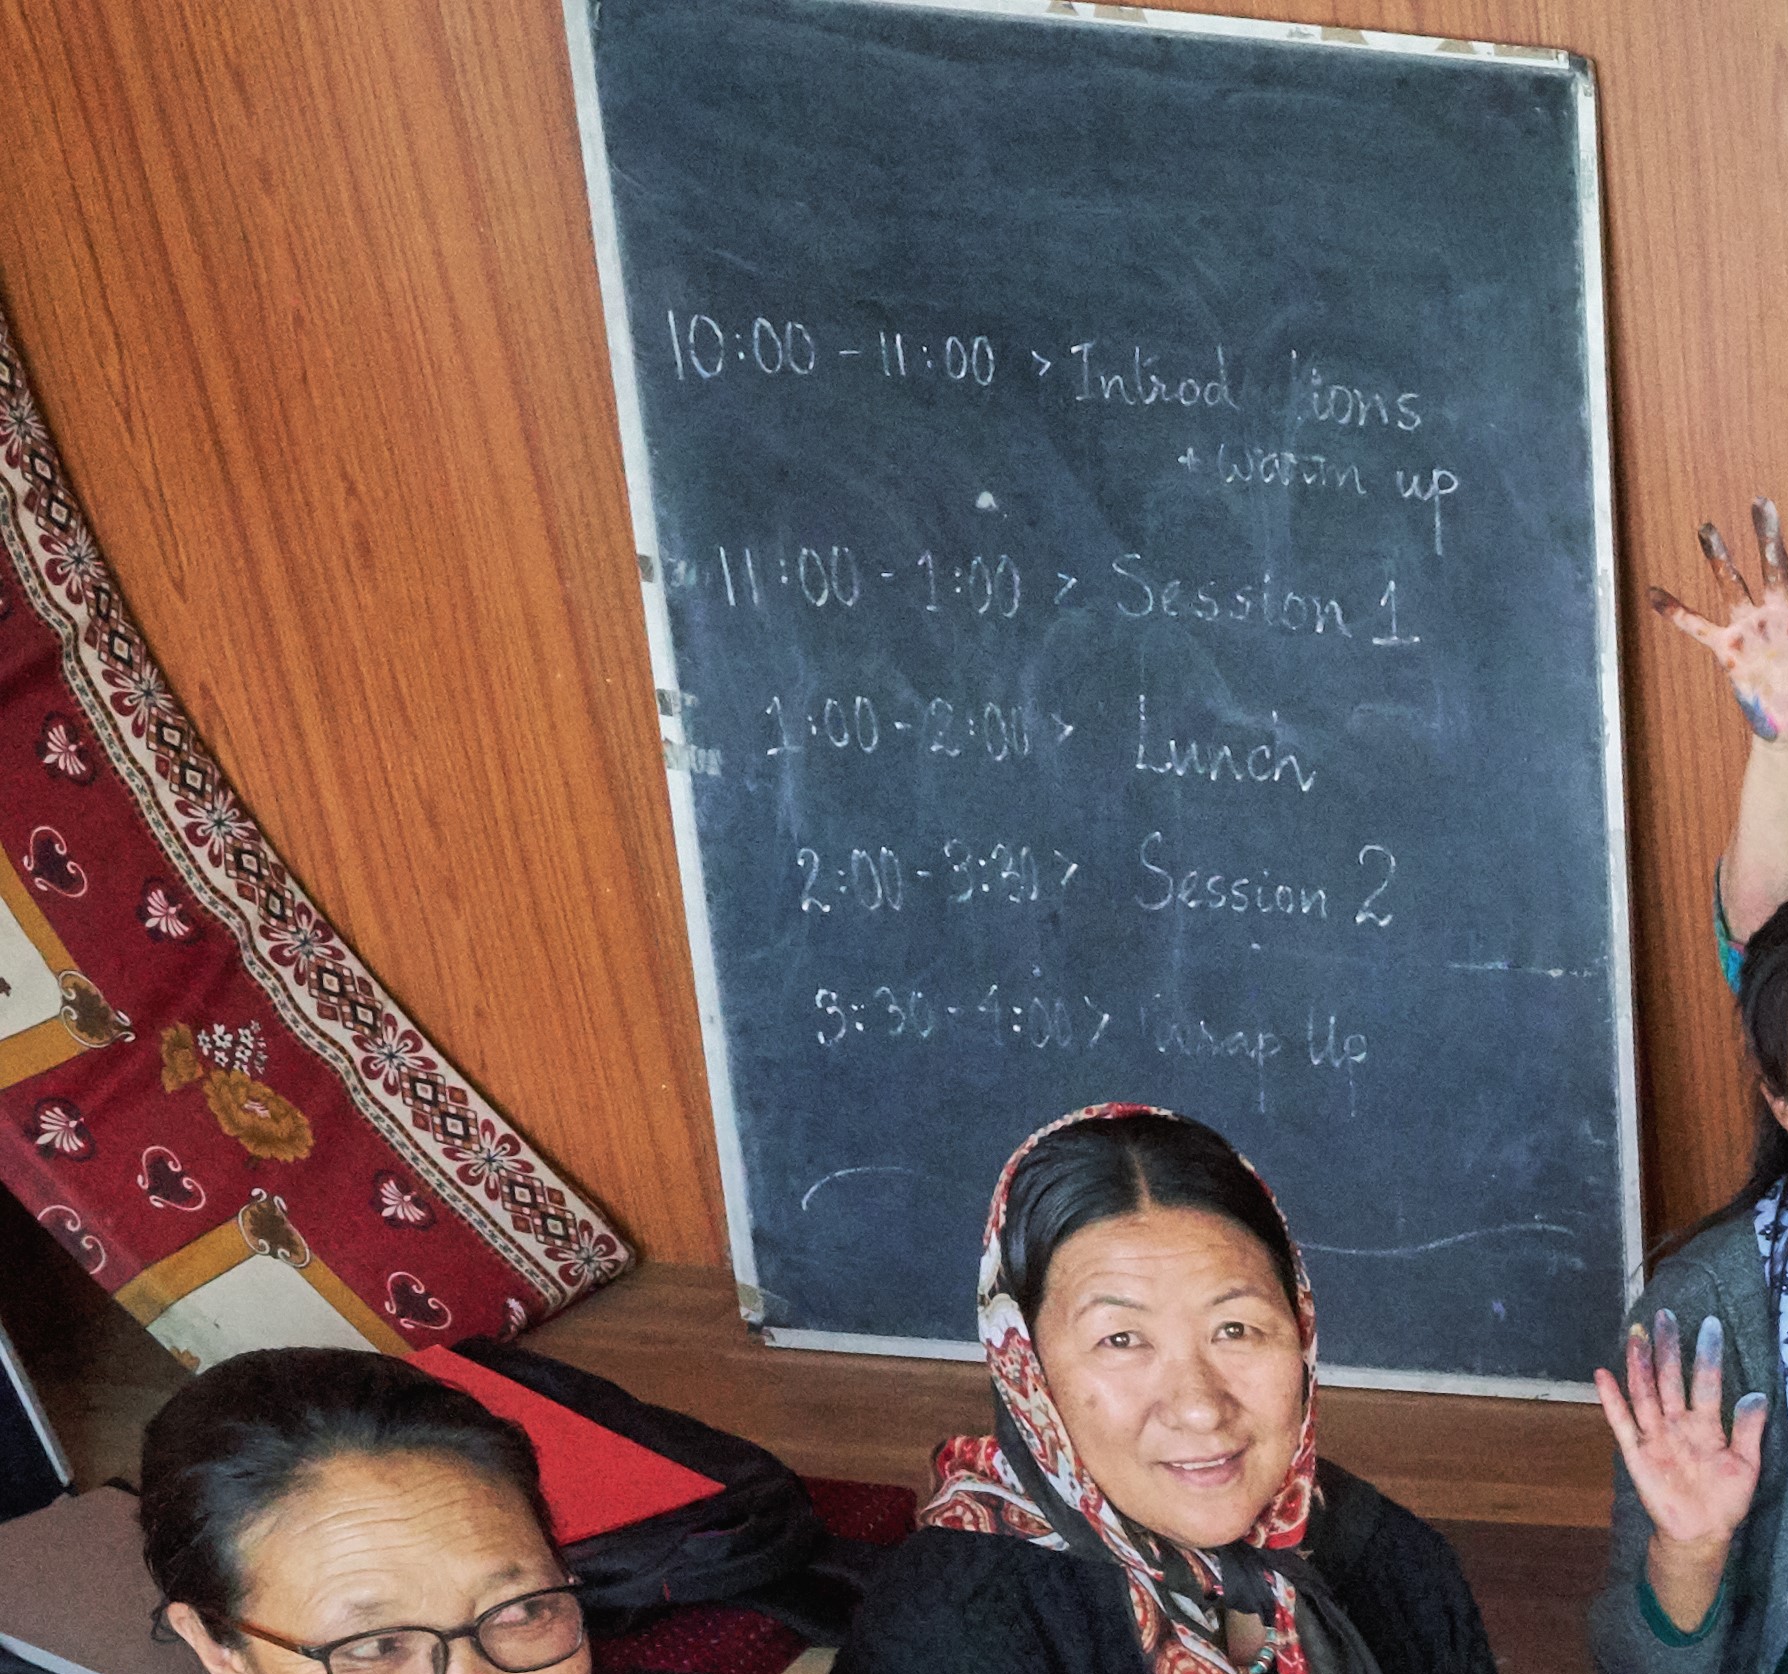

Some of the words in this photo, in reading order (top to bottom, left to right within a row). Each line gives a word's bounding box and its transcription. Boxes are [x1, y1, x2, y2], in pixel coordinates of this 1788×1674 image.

[667, 309, 815, 381] 10:00
[880, 330, 995, 386] 11:00
[1395, 467, 1459, 556] up
[719, 545, 860, 607] 11:00
[917, 549, 1021, 618] 1:00
[1111, 552, 1353, 639] Session
[766, 695, 879, 756] 1:00
[1135, 693, 1317, 792] Lunch
[796, 847, 902, 913] 2:00
[1134, 831, 1328, 919] Session
[1355, 844, 1397, 927] 2
